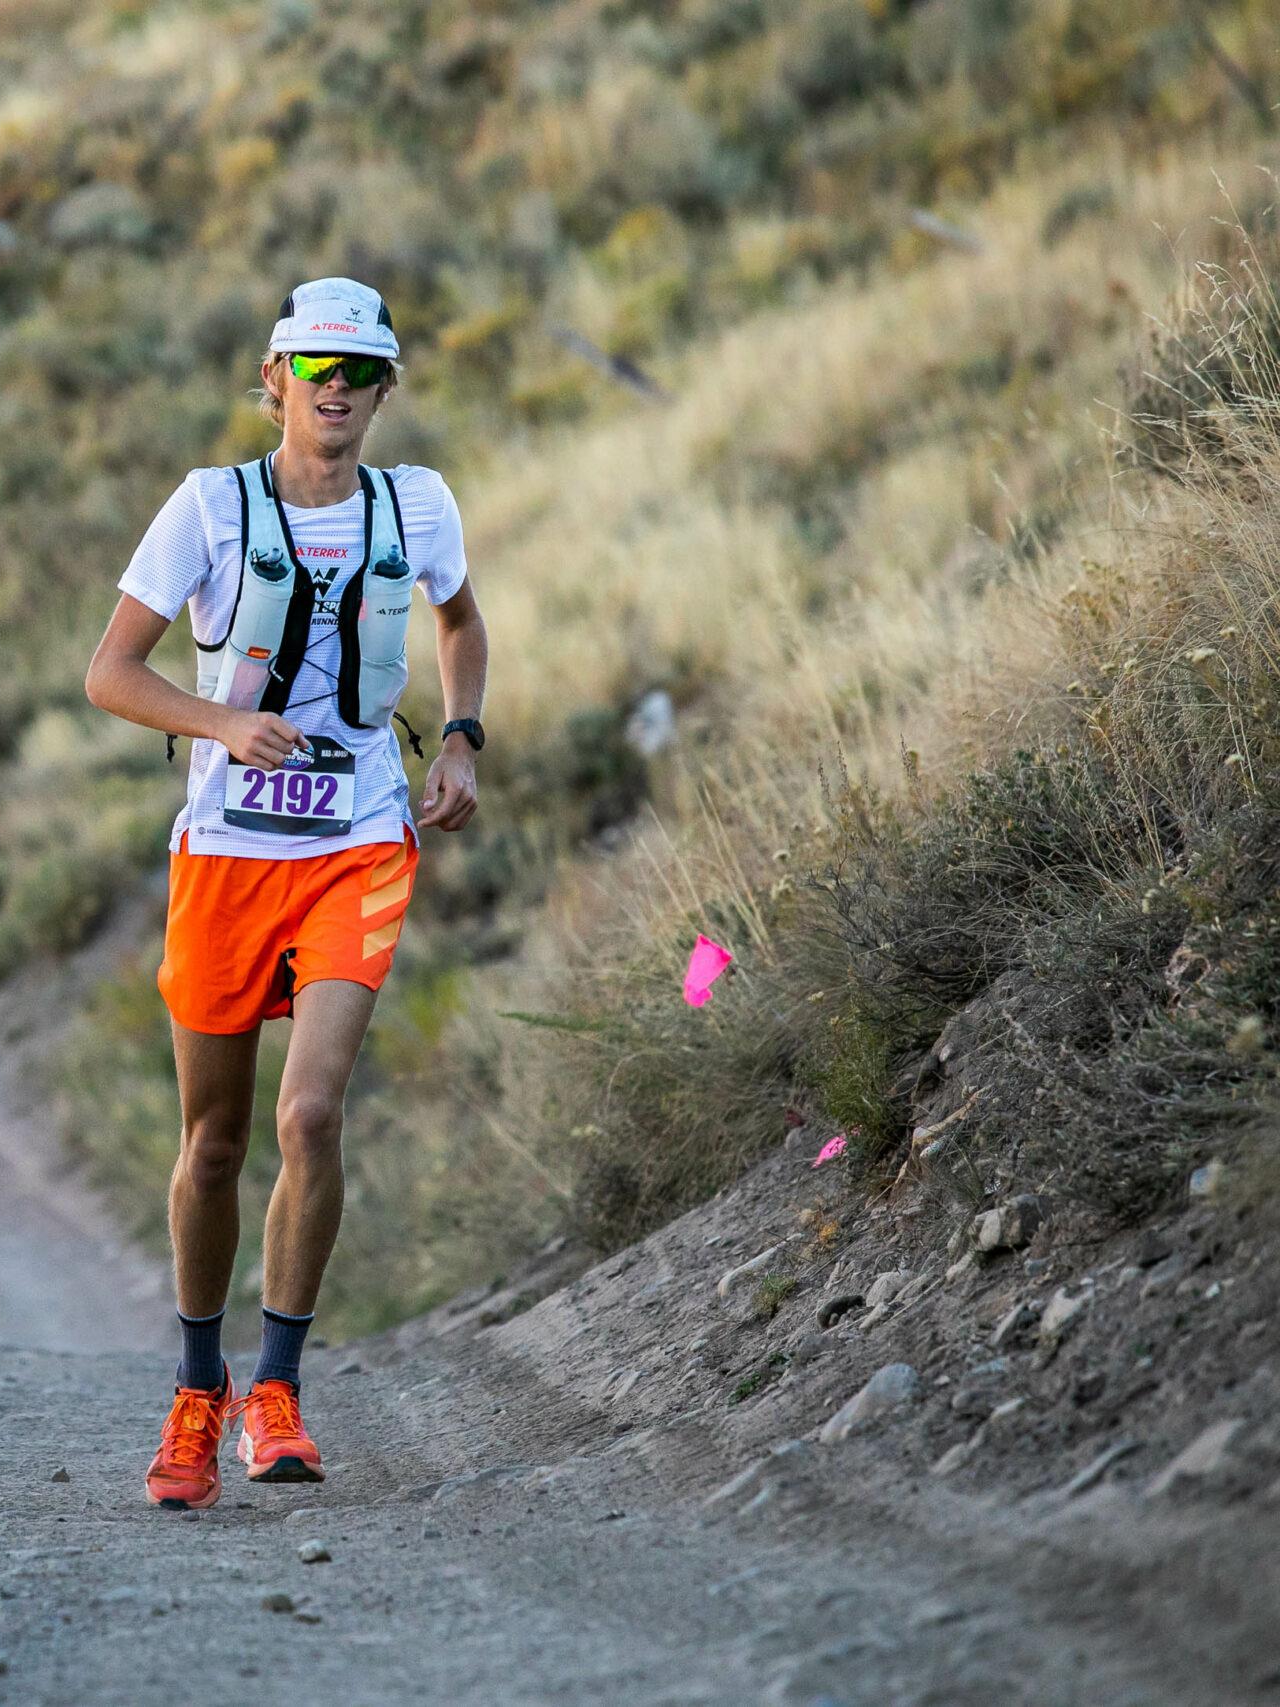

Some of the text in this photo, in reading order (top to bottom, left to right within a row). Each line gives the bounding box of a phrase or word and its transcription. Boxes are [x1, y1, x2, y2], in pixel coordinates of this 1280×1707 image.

[322, 323, 358, 333] TERREX
[307, 547, 348, 558] TERREX
[241, 768, 339, 816] 2192
